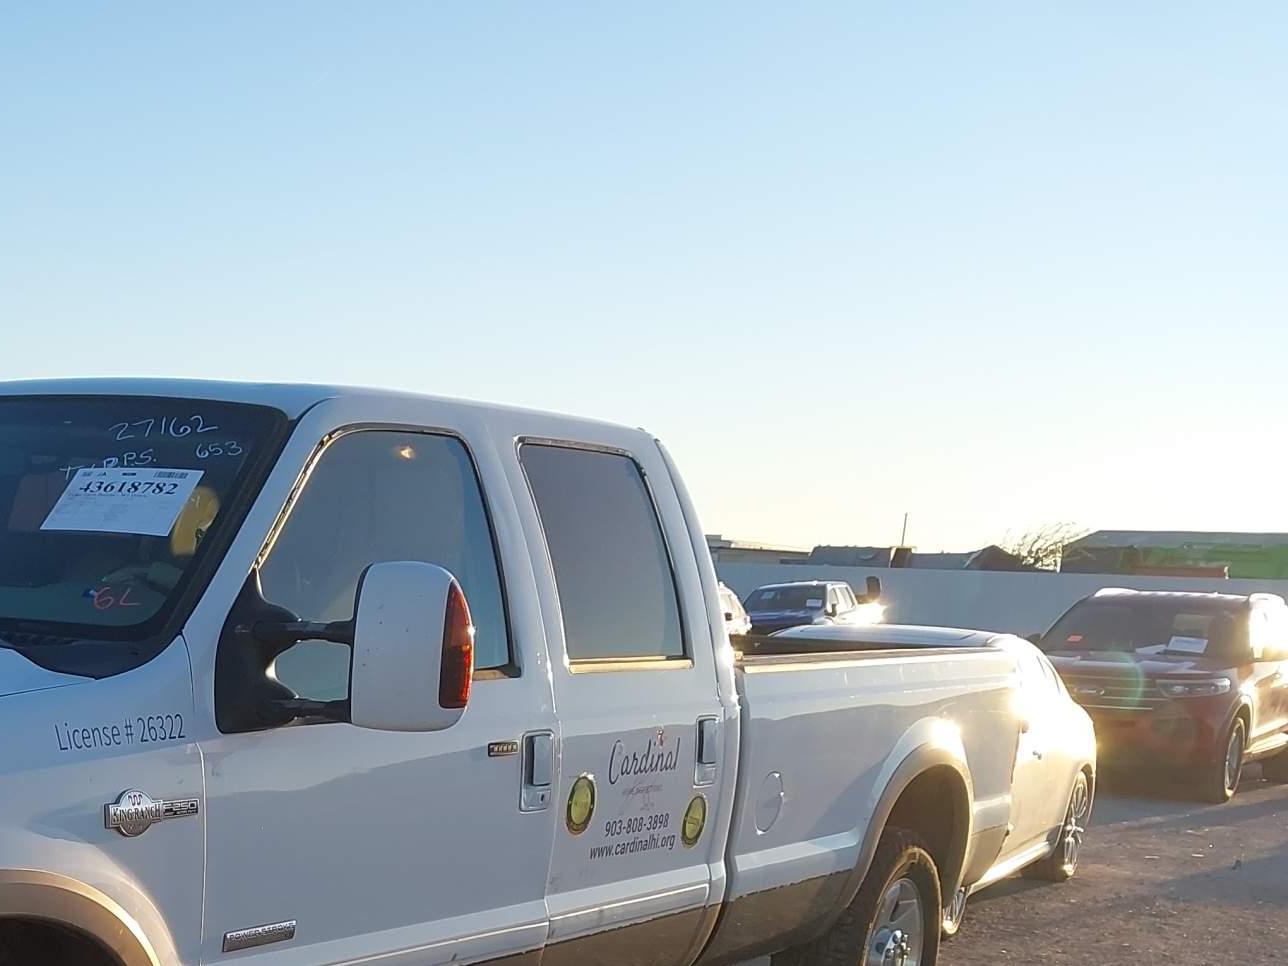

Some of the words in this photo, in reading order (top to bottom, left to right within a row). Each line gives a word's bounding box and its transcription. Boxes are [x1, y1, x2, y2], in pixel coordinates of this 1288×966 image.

[108, 415, 218, 441] 27162
[196, 441, 243, 459] 653
[79, 481, 179, 495] 43618782
[54, 721, 121, 751] License
[124, 717, 133, 745] #
[136, 713, 187, 743] 26322
[608, 737, 681, 785] Cardinal
[113, 807, 133, 823] KING
[134, 804, 161, 820] RANCH
[604, 812, 670, 838] 903-808-3898
[589, 834, 676, 860] www.cardinalhi.org
